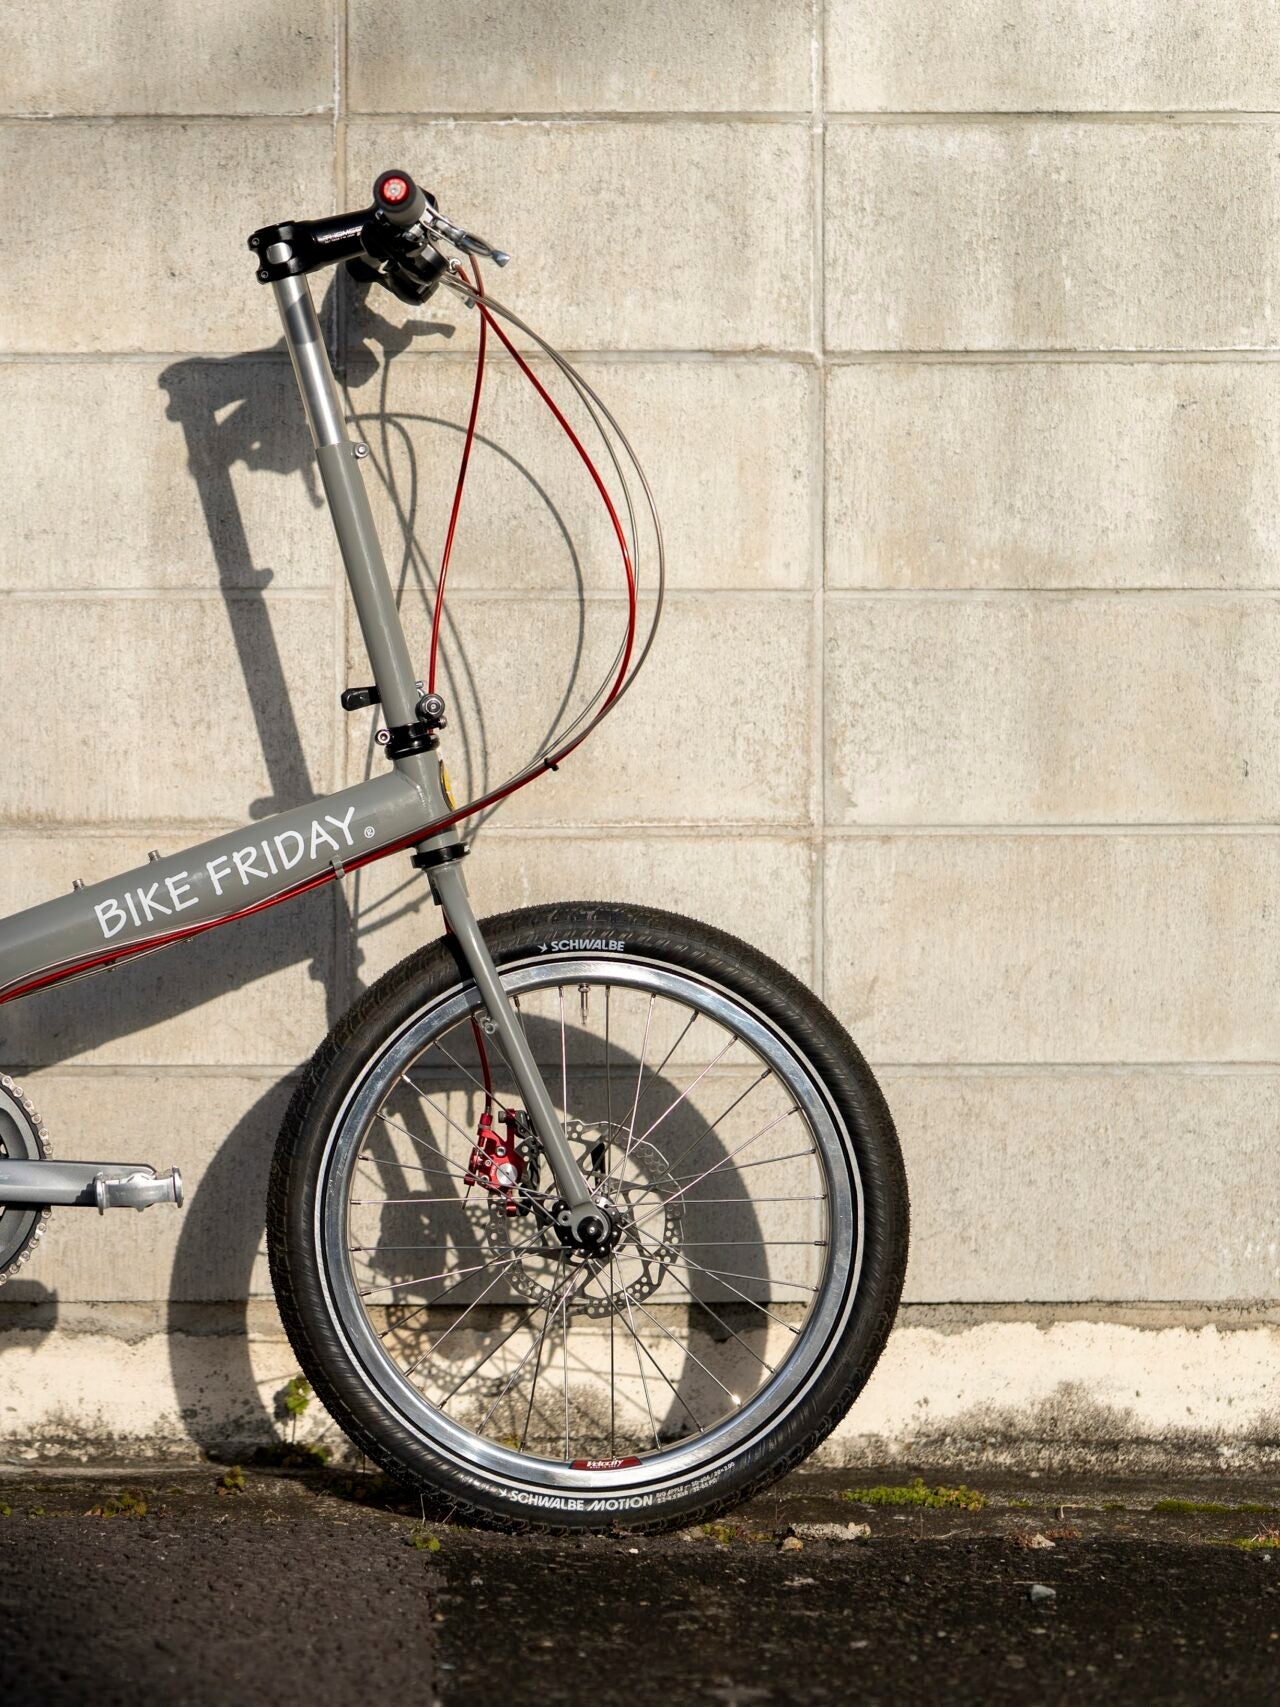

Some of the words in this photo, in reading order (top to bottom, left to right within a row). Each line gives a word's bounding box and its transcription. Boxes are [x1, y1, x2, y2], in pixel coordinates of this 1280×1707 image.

[93, 870, 200, 939] BIKE
[550, 938, 626, 952] SCHWALBE
[586, 1459, 624, 1467] Velocity
[509, 1490, 584, 1511] SCHWALBE
[585, 1494, 653, 1511] MOTION
